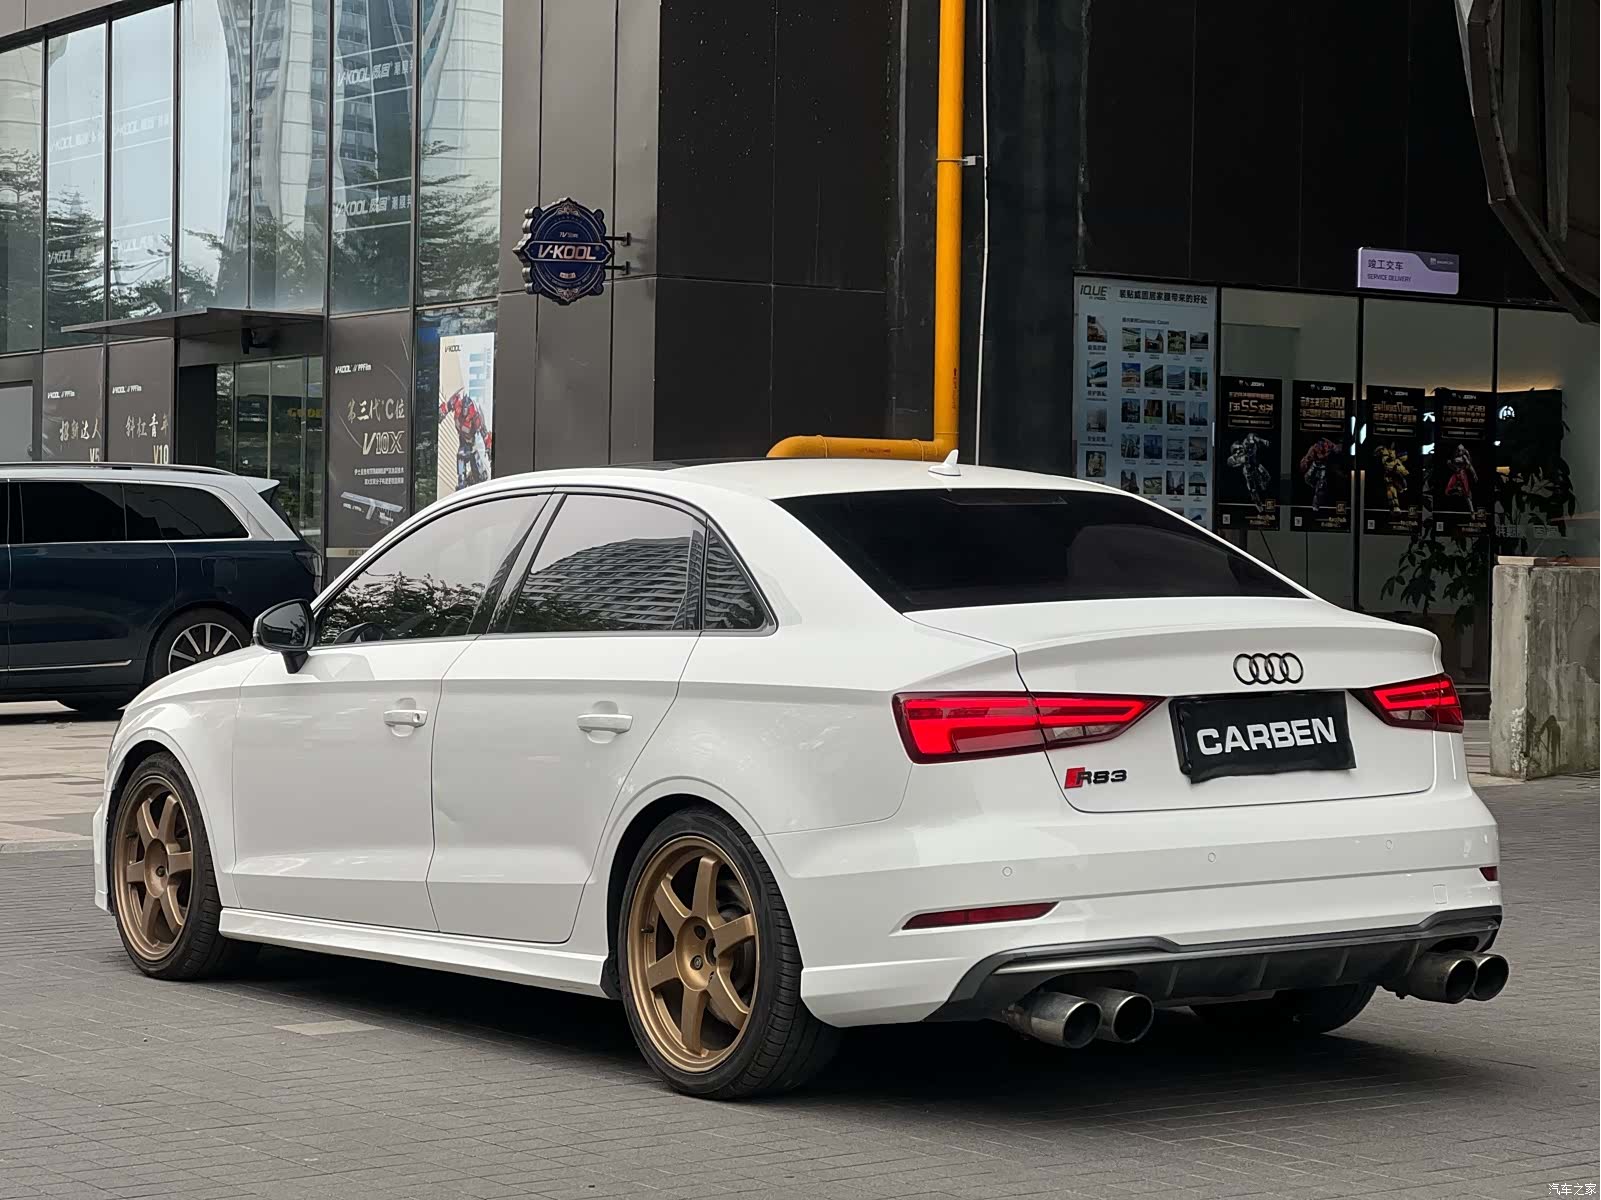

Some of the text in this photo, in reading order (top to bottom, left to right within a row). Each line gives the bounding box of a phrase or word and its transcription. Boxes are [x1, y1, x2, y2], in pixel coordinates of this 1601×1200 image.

[538, 244, 597, 261] V-KOOL
[1368, 258, 1404, 271] 竣工交车
[1367, 273, 1412, 282] SERVICE DELIVERY
[1080, 284, 1107, 297] iQUE
[363, 431, 405, 456] V10X
[152, 444, 169, 464] V10
[1196, 716, 1338, 756] CARBEN
